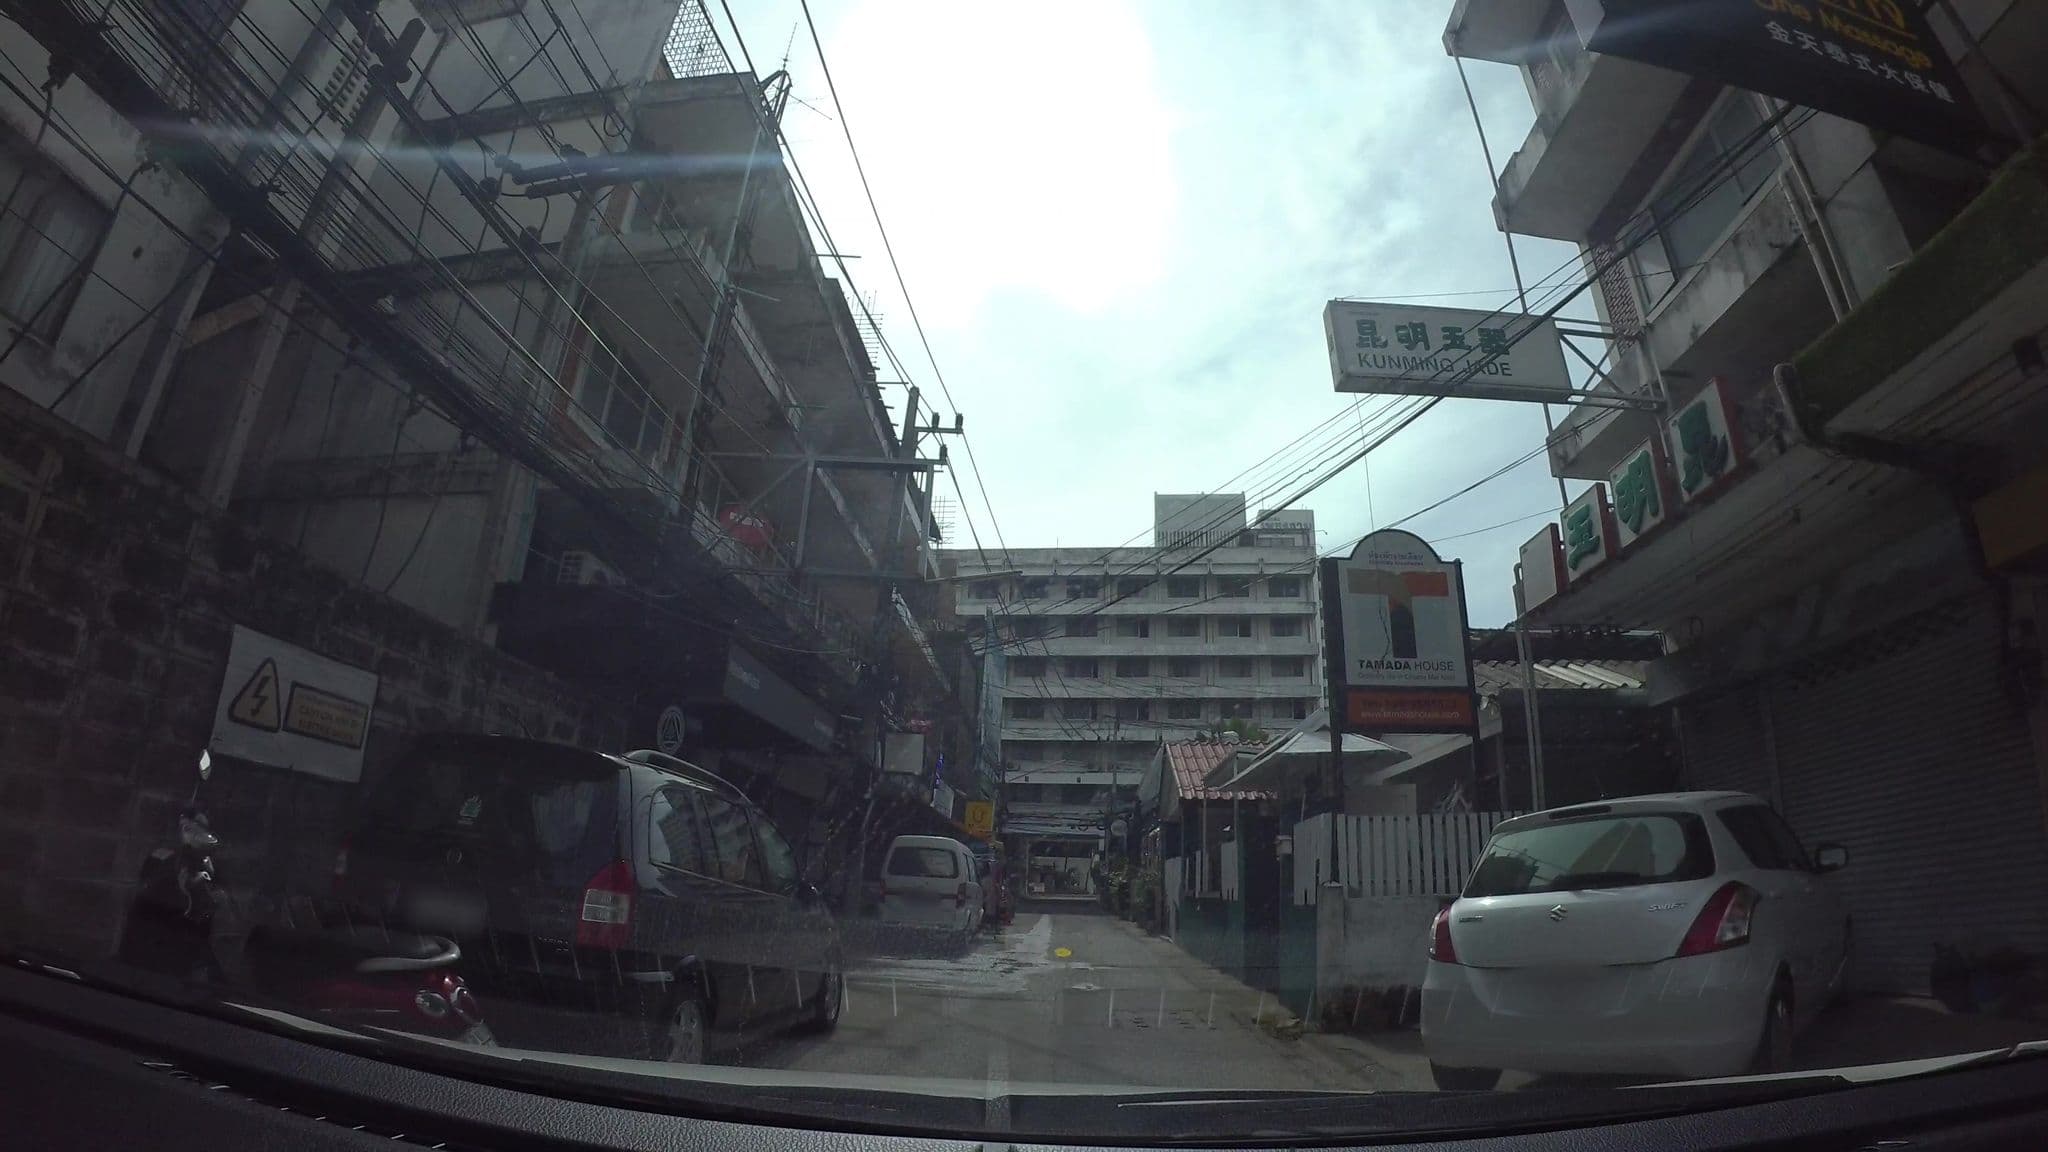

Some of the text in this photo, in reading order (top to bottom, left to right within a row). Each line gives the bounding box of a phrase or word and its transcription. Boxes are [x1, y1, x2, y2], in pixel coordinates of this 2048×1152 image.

[1818, 8, 1932, 70] Massage
[1358, 352, 1513, 377] KUNMING JADE
[1358, 659, 1454, 672] TAMADA HOUSE
